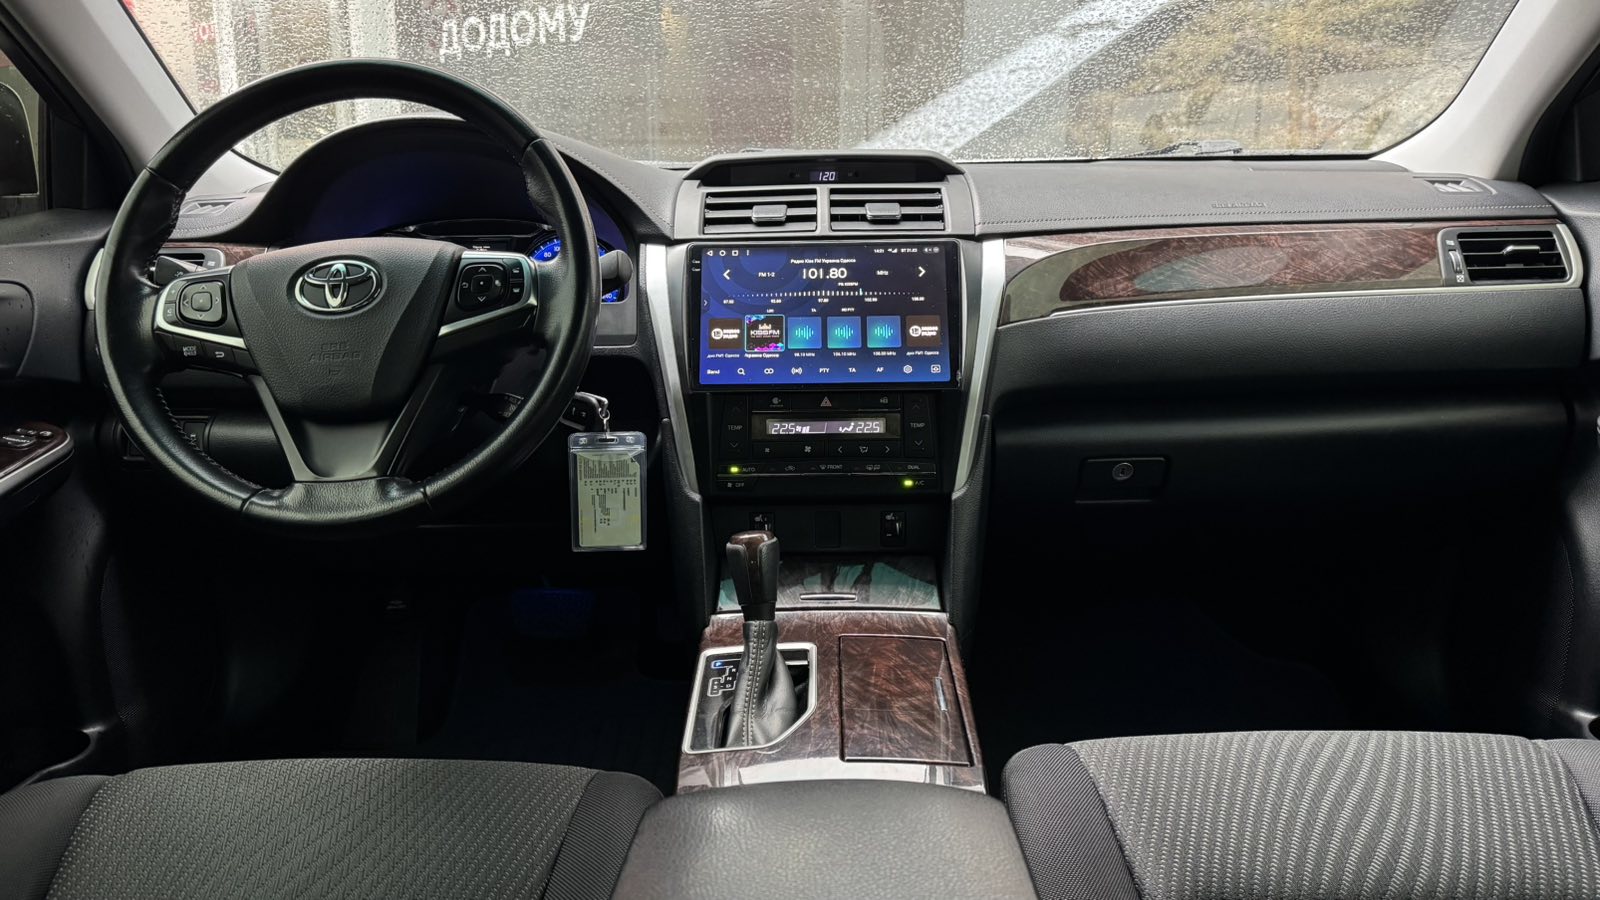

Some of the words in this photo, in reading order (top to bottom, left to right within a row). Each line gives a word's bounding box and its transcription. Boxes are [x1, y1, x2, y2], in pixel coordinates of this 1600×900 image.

[438, 3, 590, 63] ДОДОМУ
[818, 171, 836, 181] 120
[802, 267, 848, 280] 101.80
